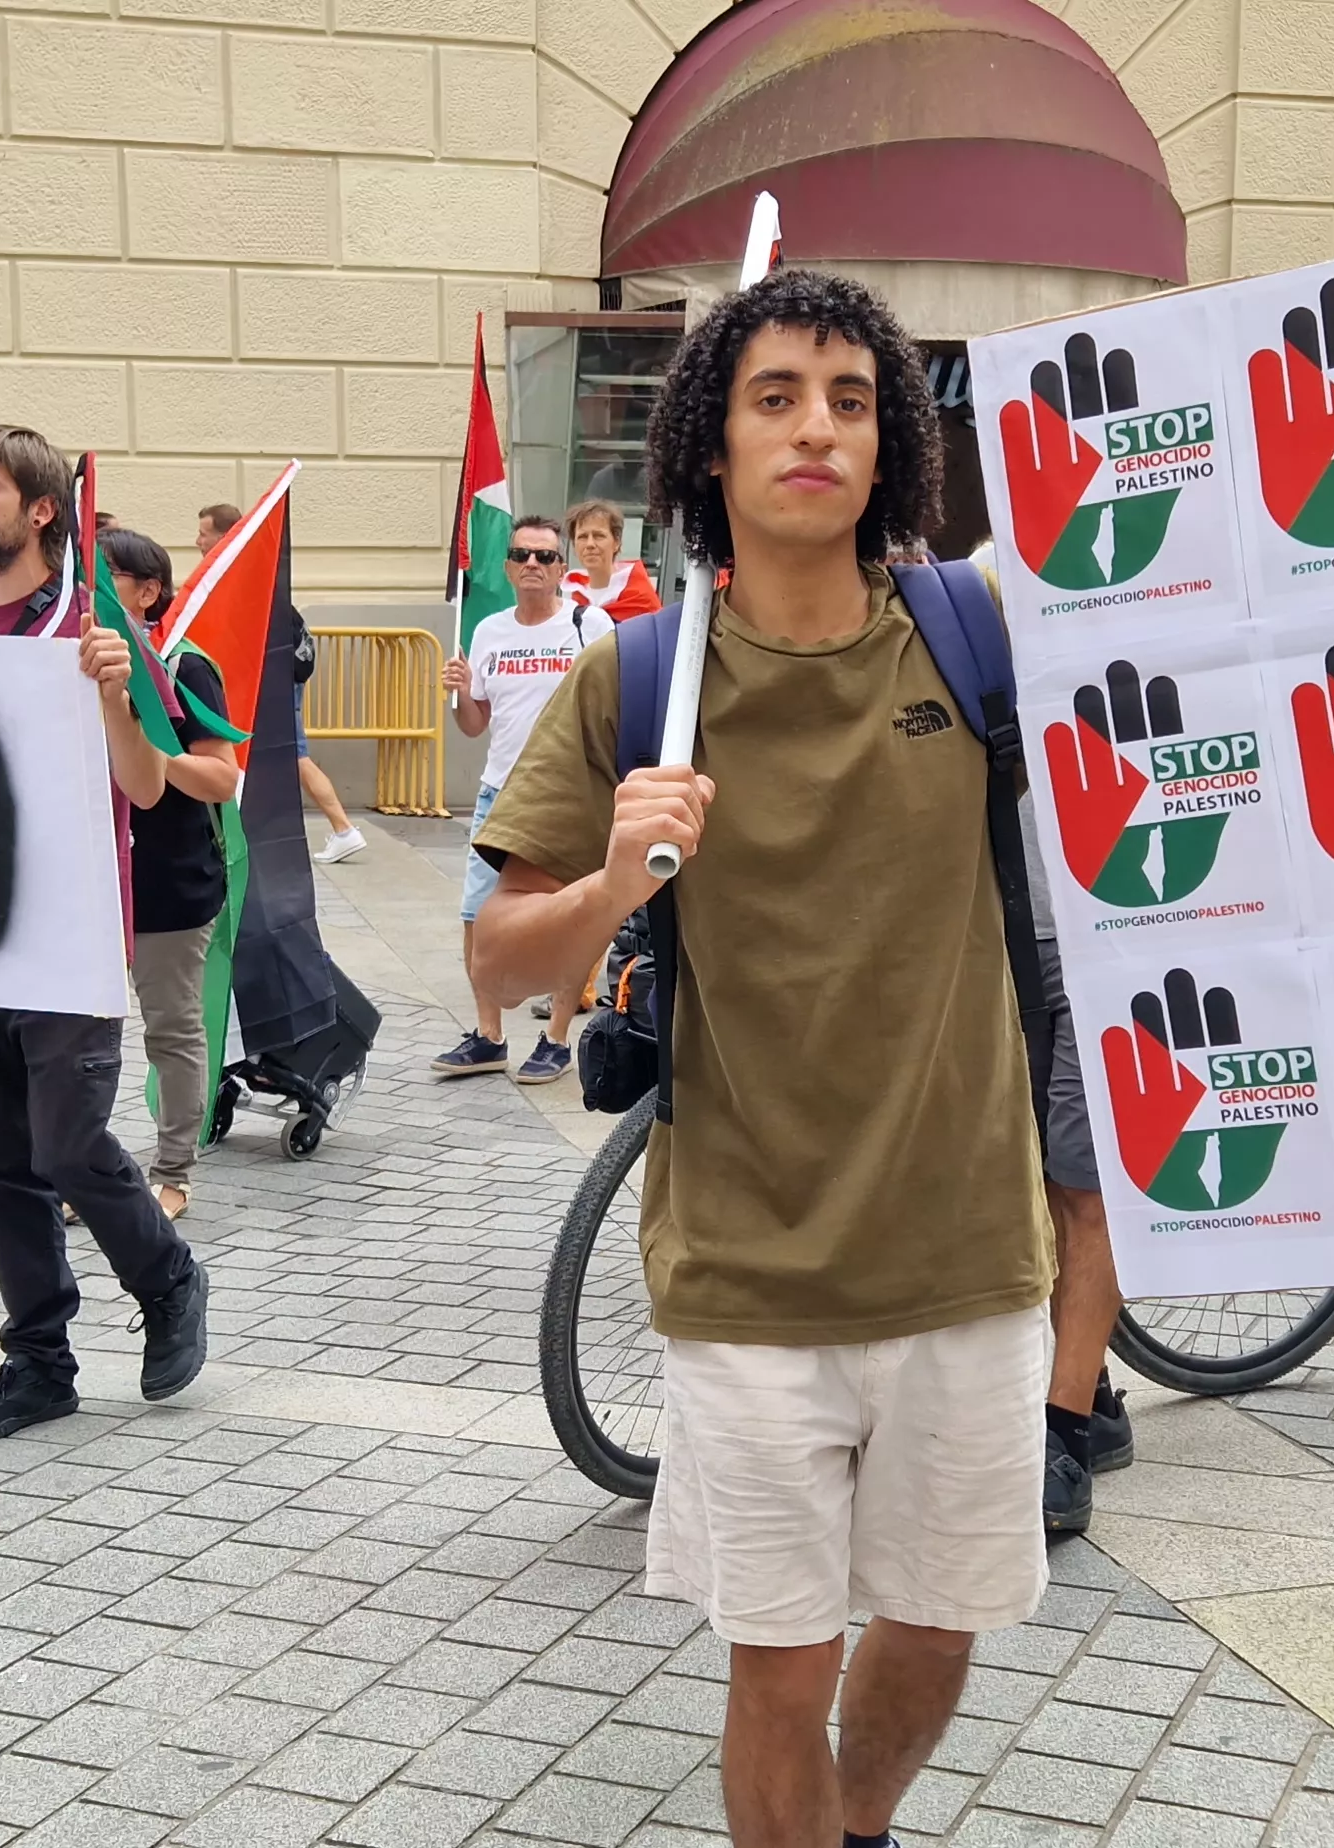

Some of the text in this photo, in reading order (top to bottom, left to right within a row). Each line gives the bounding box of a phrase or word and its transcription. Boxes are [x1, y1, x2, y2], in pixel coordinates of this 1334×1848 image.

[1108, 406, 1210, 456] STOP
[1114, 442, 1212, 474] GENOCIDIO
[1115, 462, 1214, 493] PALESTINO
[1041, 579, 1212, 616] #STOPGENOCIDIOPALESTINO
[497, 657, 572, 676] PALESTINA
[499, 648, 557, 659] HUESCA CON
[892, 714, 929, 731] NORTH
[1153, 735, 1255, 780] STOP
[1161, 770, 1258, 797] GENOCIDIO
[1163, 789, 1262, 816] PALESTINO
[1094, 900, 1265, 932] #STOPGENOCIDIOPALESTINO
[1211, 1049, 1312, 1088] STOP
[1219, 1084, 1315, 1105] GENOCIDIO
[1220, 1102, 1319, 1123] PALESTINO
[1150, 1211, 1322, 1233] #STOPGENOCIDIOPALESTINO
